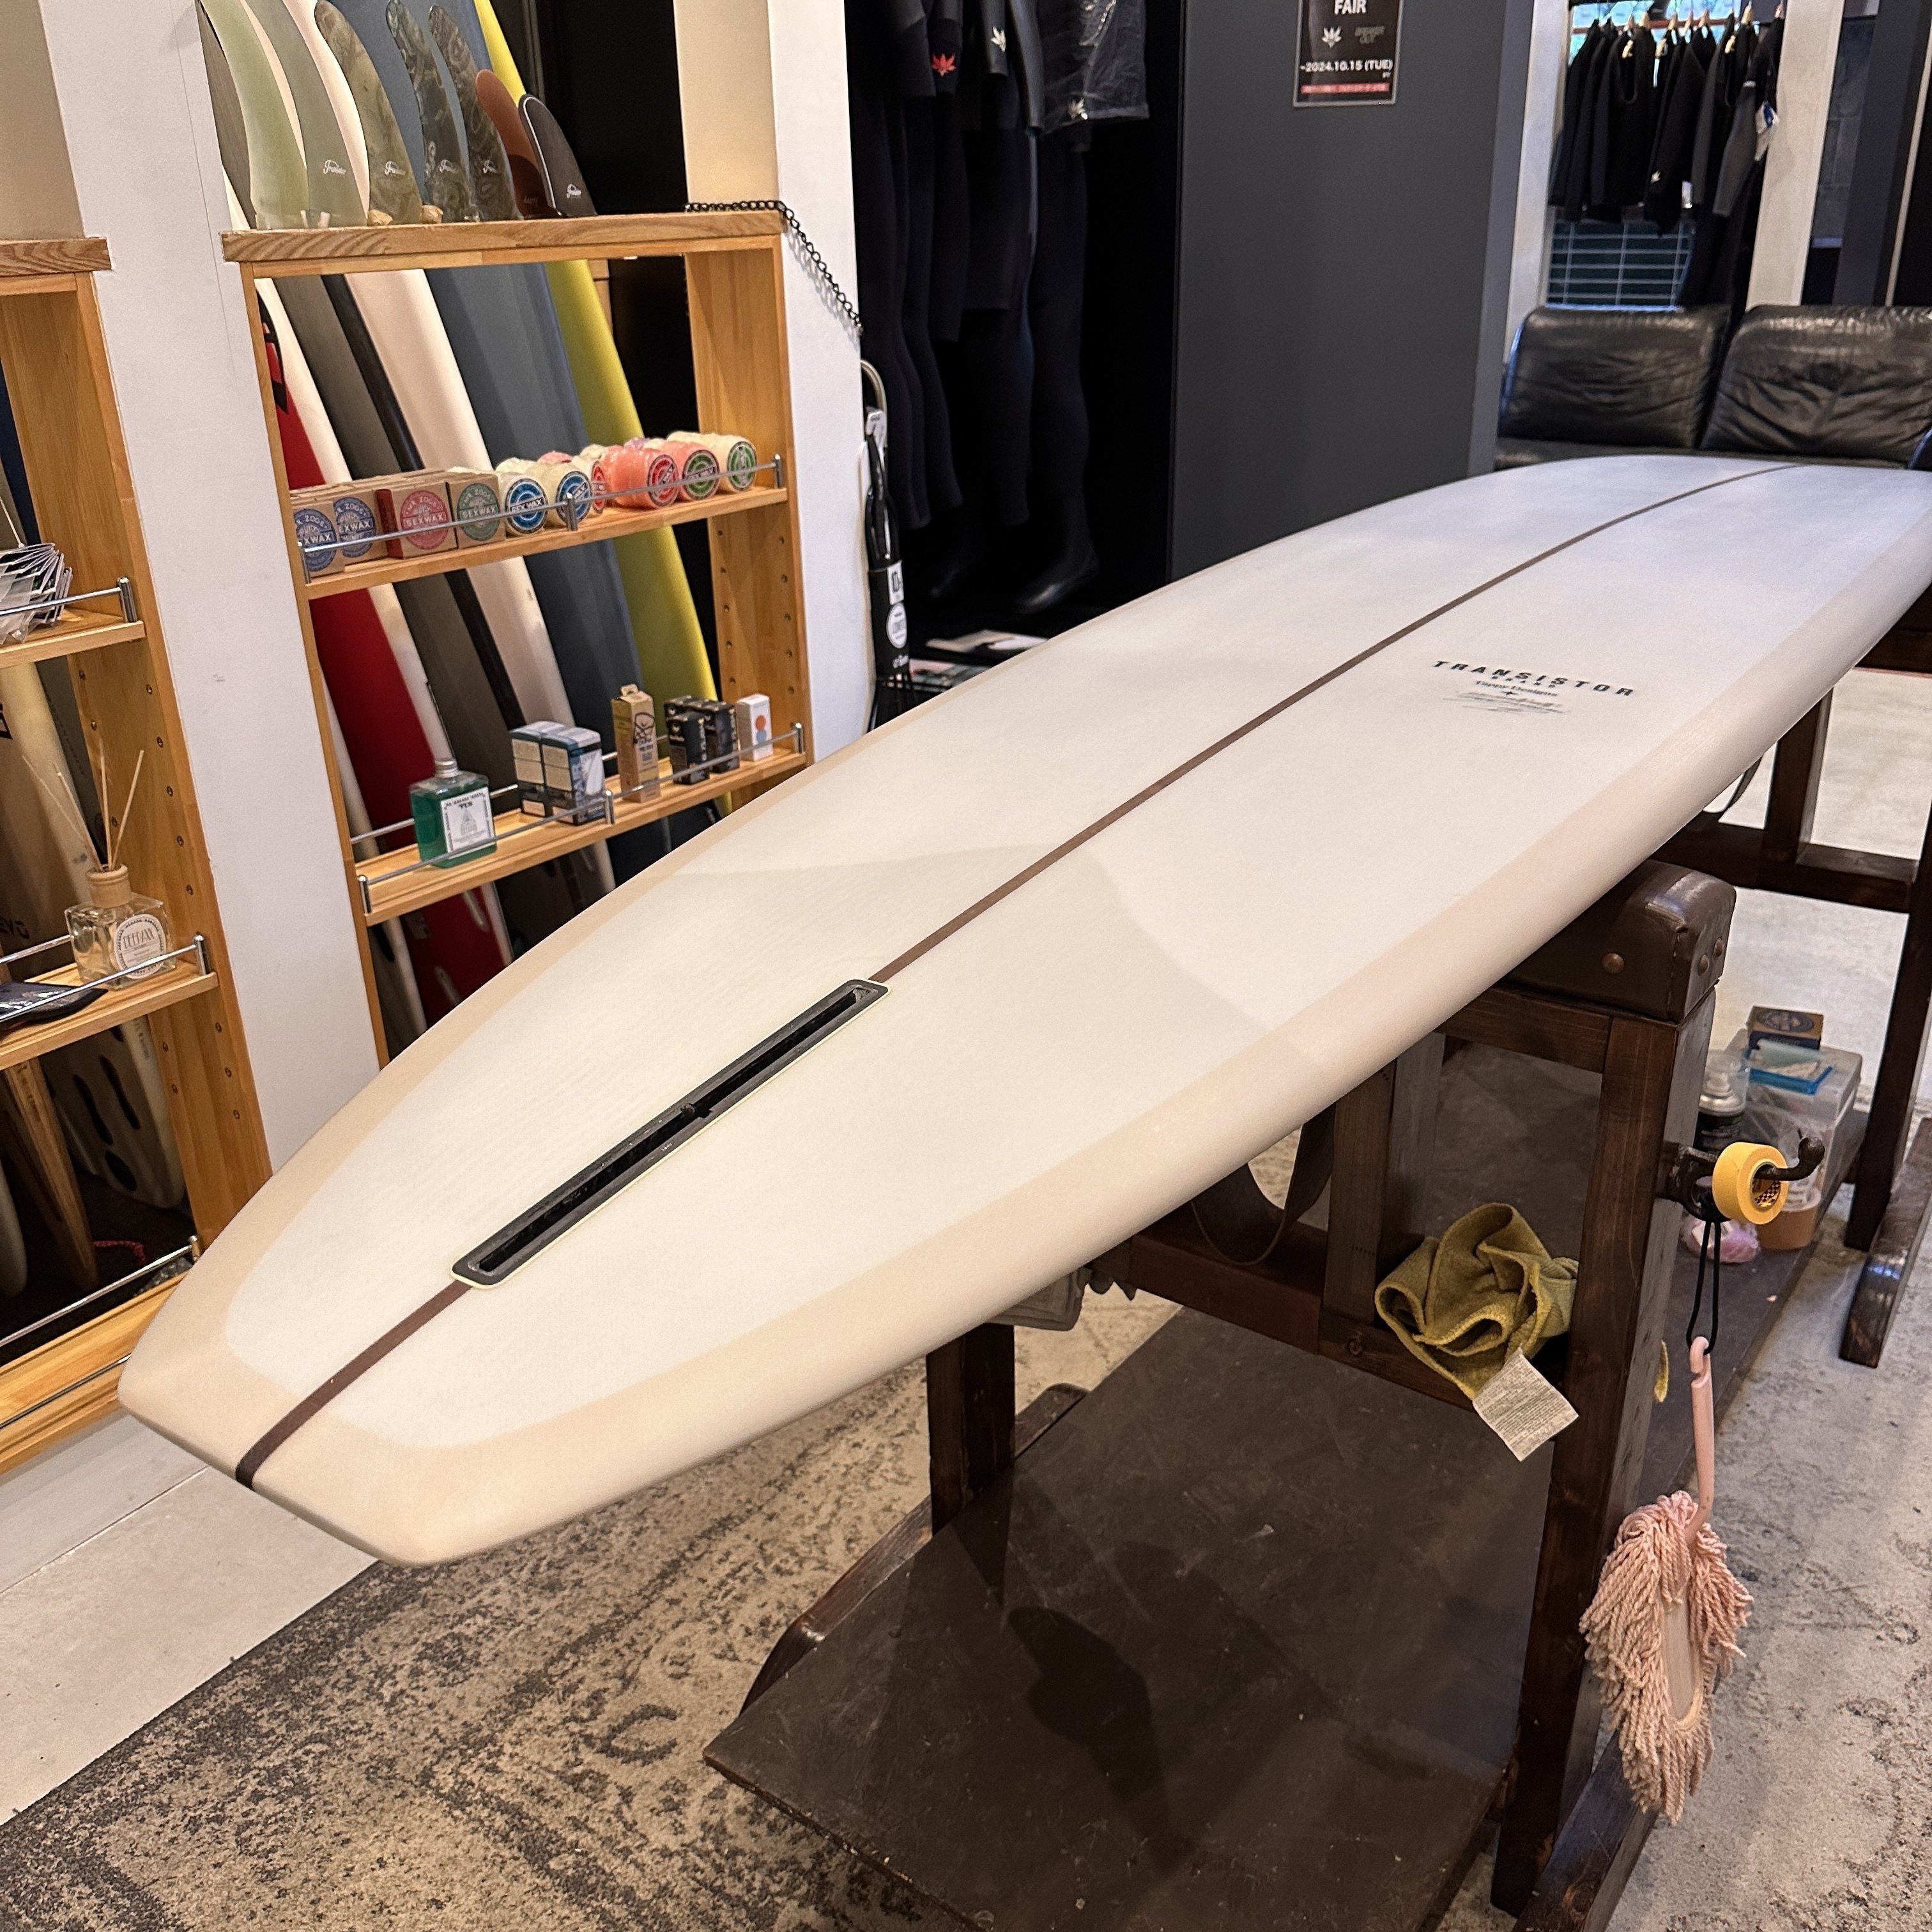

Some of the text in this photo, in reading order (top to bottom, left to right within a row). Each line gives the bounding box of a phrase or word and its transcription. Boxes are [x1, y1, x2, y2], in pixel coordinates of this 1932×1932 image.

[1334, 0, 1367, 15] FAIR
[406, 512, 444, 527] SEXWAX
[1434, 660, 1634, 696] TRANSISTOR
